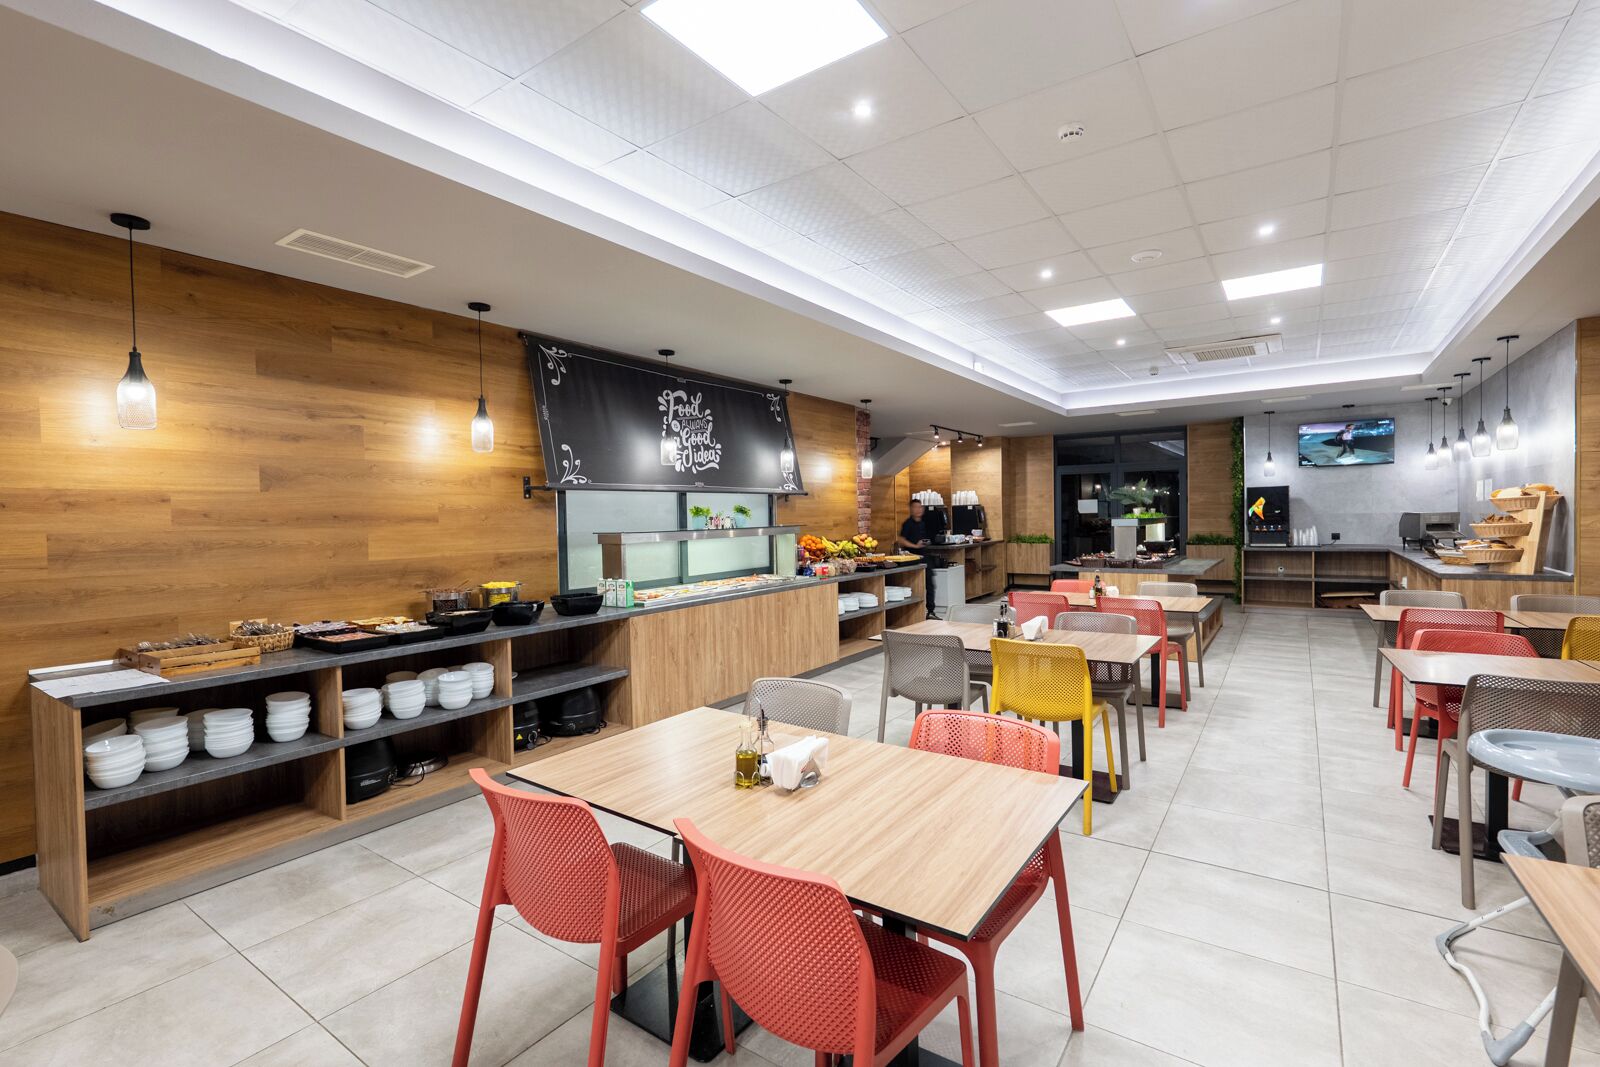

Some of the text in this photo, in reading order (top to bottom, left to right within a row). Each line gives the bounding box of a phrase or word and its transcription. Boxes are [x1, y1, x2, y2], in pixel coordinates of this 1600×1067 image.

[663, 390, 703, 423] Food
[682, 418, 708, 430] ALWAYS
[680, 422, 715, 467] Good
[693, 446, 720, 464] idea
